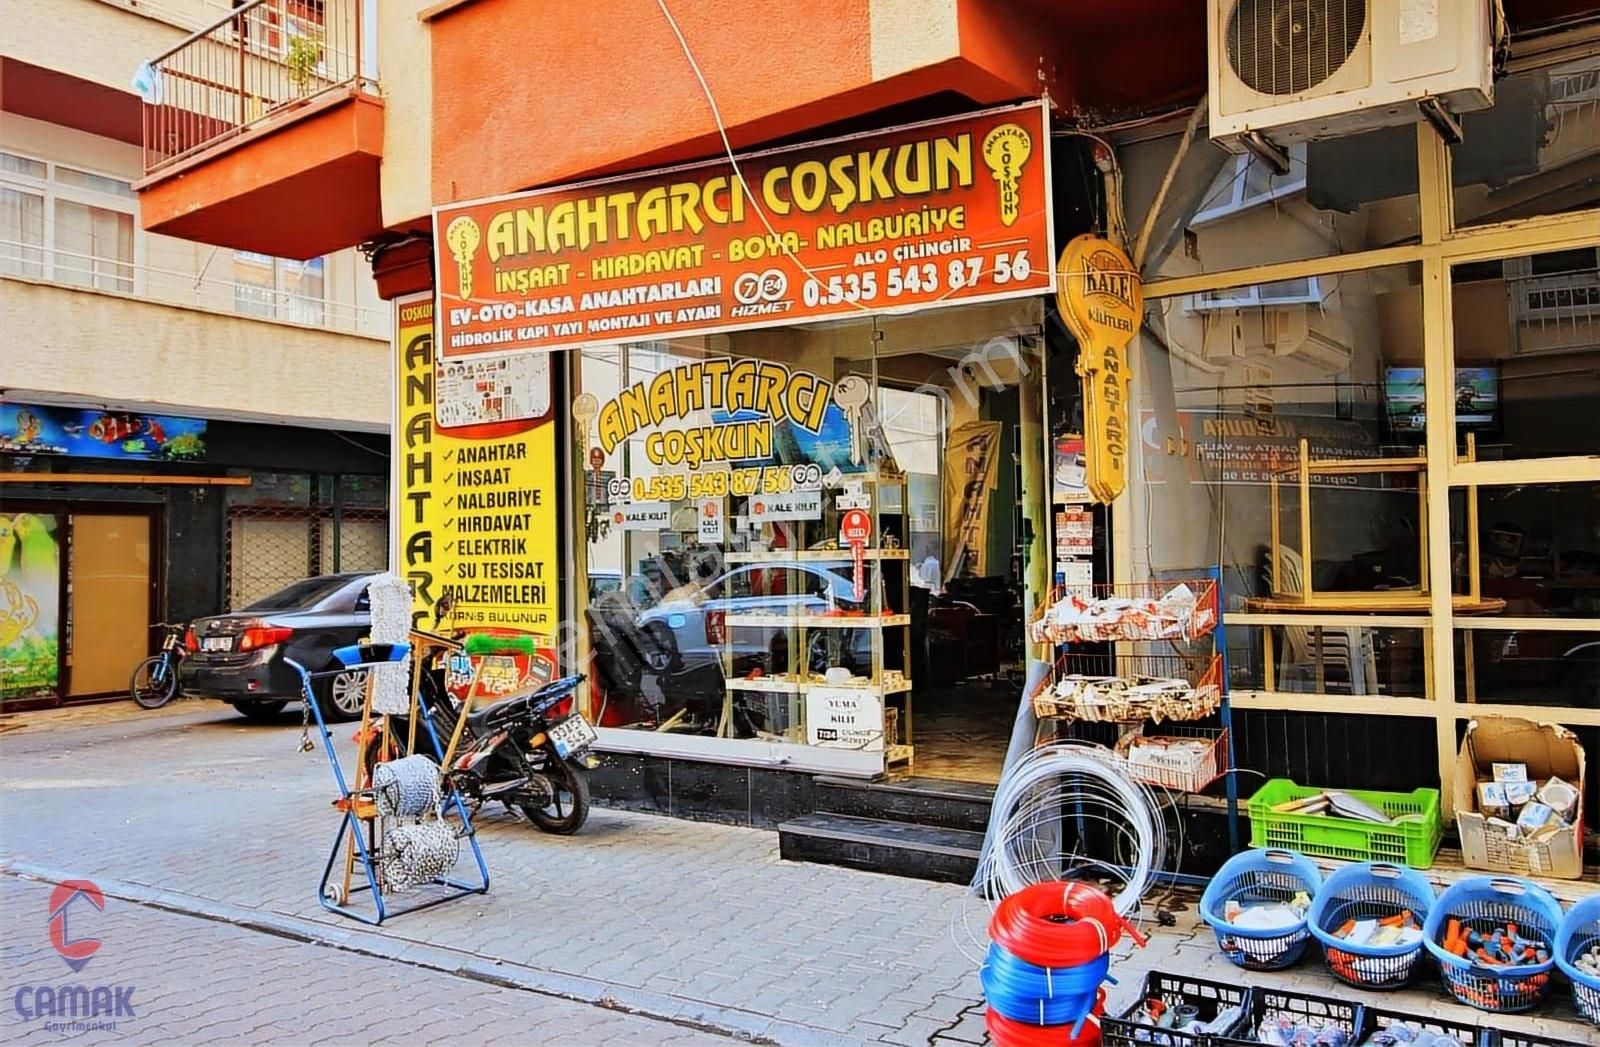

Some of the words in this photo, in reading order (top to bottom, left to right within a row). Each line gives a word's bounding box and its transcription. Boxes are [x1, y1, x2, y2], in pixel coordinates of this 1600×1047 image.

[486, 174, 745, 263] ANAHTARCI
[762, 133, 973, 214] COŞKUN
[495, 263, 570, 296] İNŞAAT
[592, 245, 704, 280] HIRDAVAT
[817, 204, 965, 250] NALBURİYE
[853, 249, 887, 267] ALO
[894, 235, 971, 263] ÇİLİNGİR
[744, 282, 755, 298] 7
[803, 269, 877, 307] 0.535
[887, 264, 937, 297] 543
[948, 257, 984, 288] 87
[993, 250, 1030, 284] 56
[1086, 265, 1132, 303] KALE
[450, 296, 575, 326] EV-OTO-KASA
[580, 276, 722, 309] ANAHTARLARI
[451, 322, 513, 348] HİDROLİK
[517, 323, 548, 341] KAPI
[552, 321, 582, 337] YAYI
[588, 314, 650, 334] MONTAJI
[655, 312, 673, 325] VE
[676, 304, 721, 322] AYARI
[599, 357, 831, 455] ANAHTARCI
[1104, 346, 1123, 470] ANAHTARCI
[457, 442, 526, 464] ANAHTAR
[646, 420, 773, 471] COŞKUN
[457, 467, 511, 488] İNŞAAT
[689, 468, 730, 498] 543
[732, 466, 759, 497] 87
[763, 464, 791, 494] 56
[457, 487, 541, 510] NALBURİYE
[767, 504, 793, 513] KALE
[457, 514, 531, 532] HIRDAVAT
[458, 535, 527, 556] ELEKTRİK
[457, 562, 477, 579] SU
[483, 559, 544, 579] TESİSAT
[441, 581, 546, 604] MALZEMELERİ
[489, 611, 547, 624] BULUNUR
